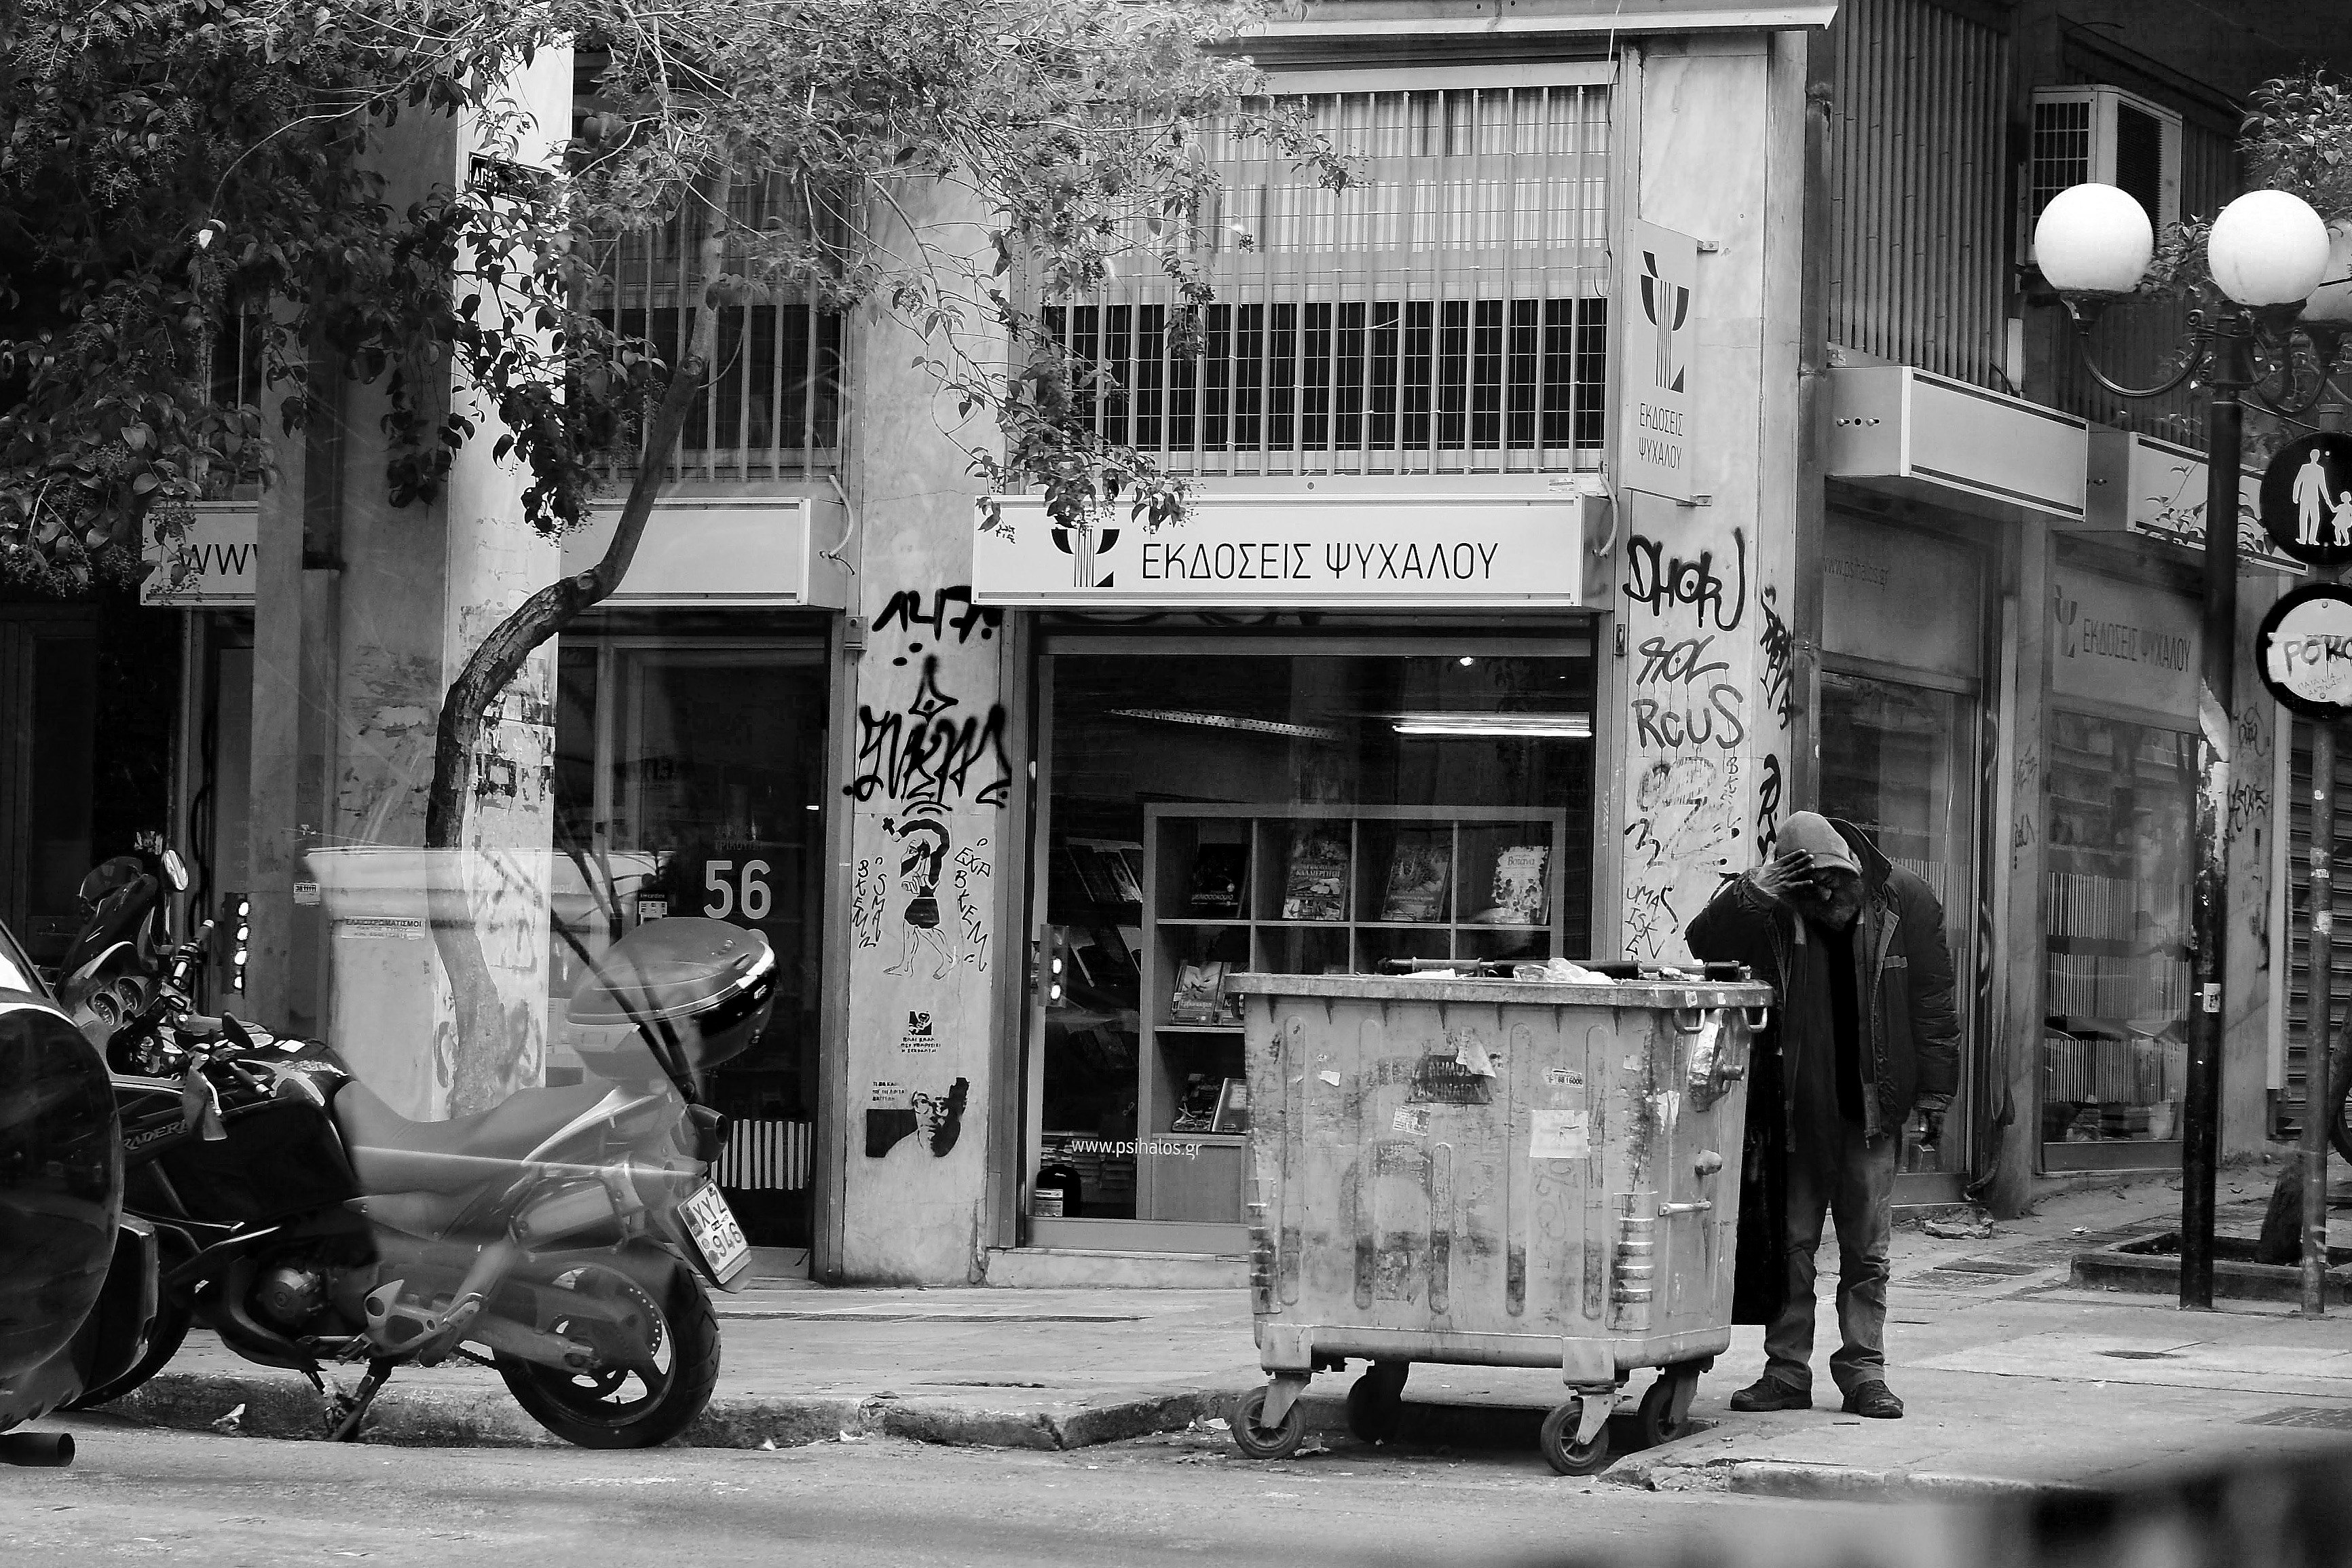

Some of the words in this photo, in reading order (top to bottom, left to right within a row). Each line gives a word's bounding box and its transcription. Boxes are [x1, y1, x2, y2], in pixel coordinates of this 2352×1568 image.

[1639, 402, 1683, 436] ΕΚΔΟΣΕΙΣ
[1638, 436, 1682, 470] ΨΥΧΑΛΟΥ
[1142, 543, 1311, 580] ΕΚΔΟΣΕΙΣ
[1326, 542, 1499, 580] ΨΥΧΑΛΟΥ
[2083, 618, 2138, 662] ΕΚΔΟΣΕΙΣ
[703, 860, 771, 920] 56
[1427, 1061, 1473, 1077] ΔΗΜΟ
[1071, 1138, 1203, 1160] www.psihalos.gr
[692, 1189, 728, 1228] XYZ
